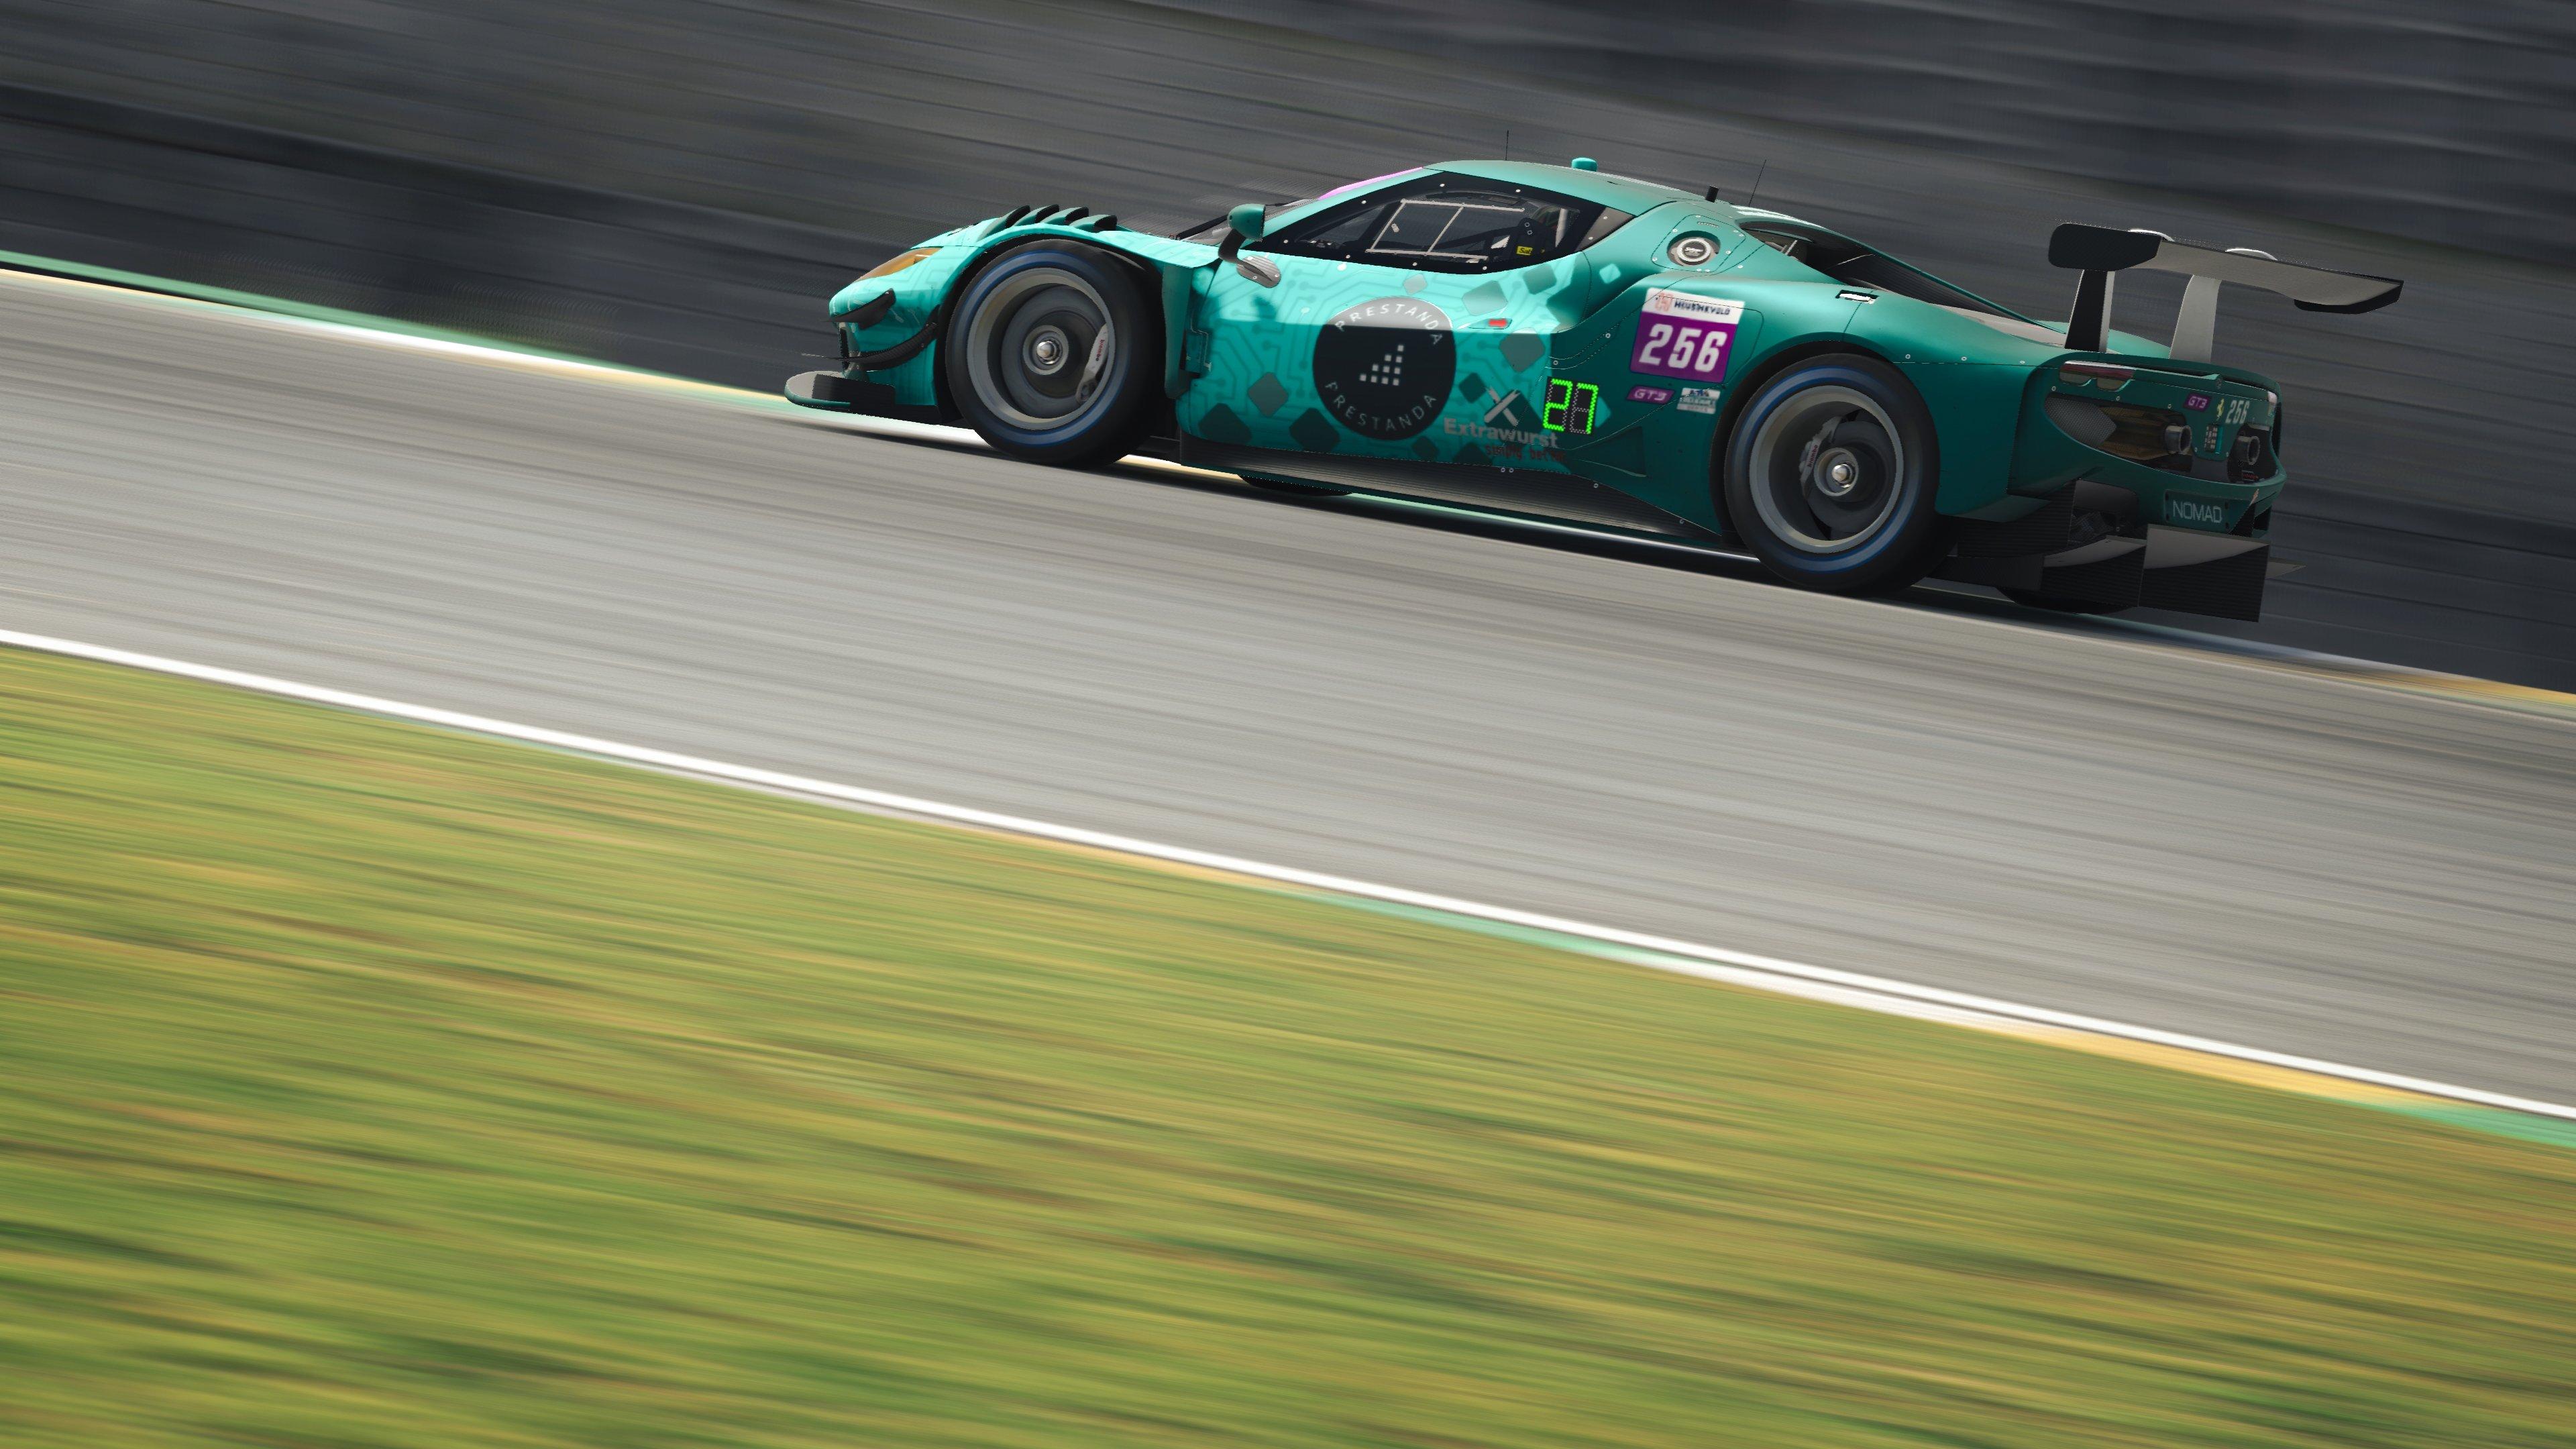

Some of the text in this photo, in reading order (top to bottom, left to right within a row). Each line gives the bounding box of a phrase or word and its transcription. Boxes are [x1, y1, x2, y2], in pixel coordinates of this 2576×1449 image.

[1335, 304, 1443, 345] PRESTANDA
[1095, 339, 1105, 361] brembo
[1639, 323, 1727, 372] 256
[1325, 382, 1437, 431] PRESTANDA
[1543, 378, 1599, 435] 27
[1634, 388, 1667, 401] GT3
[2188, 396, 2208, 409] GT3
[2225, 400, 2250, 424] 256
[1444, 417, 1558, 447] Extrawurst
[2172, 500, 2222, 523] NOMAD
